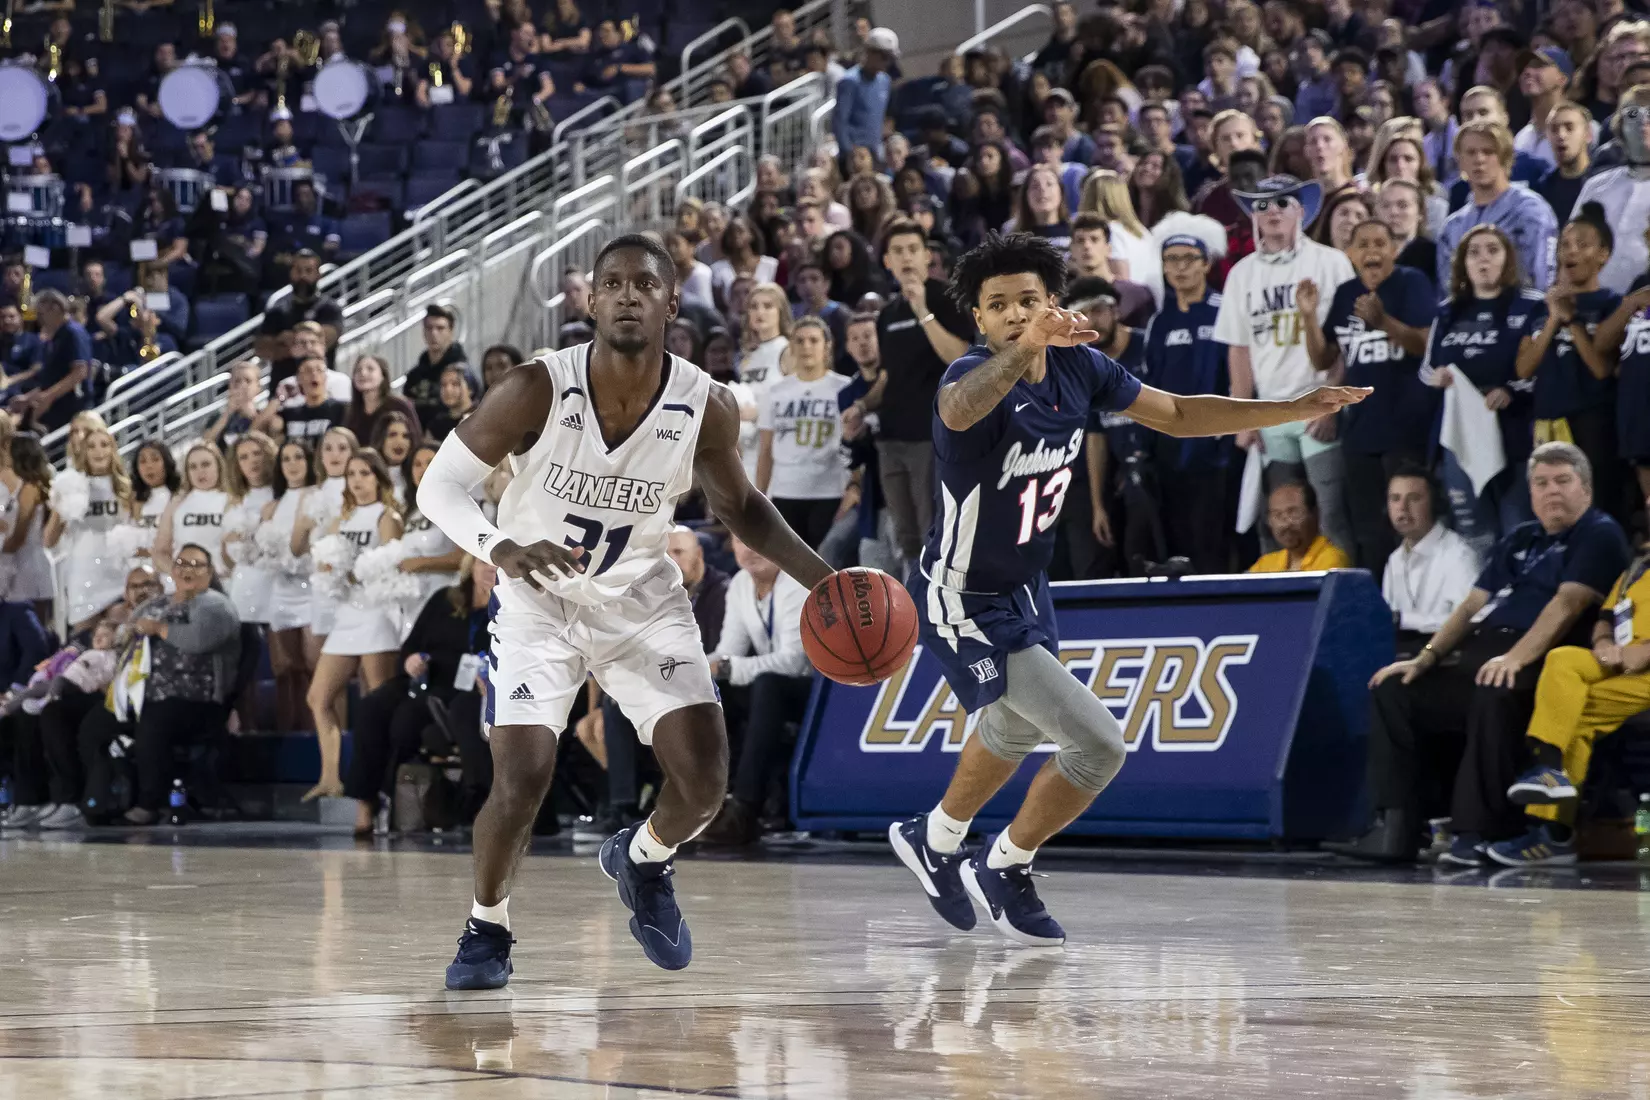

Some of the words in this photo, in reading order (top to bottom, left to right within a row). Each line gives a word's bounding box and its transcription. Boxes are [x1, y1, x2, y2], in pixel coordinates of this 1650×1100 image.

[1247, 283, 1298, 317] LANC
[1441, 330, 1499, 347] CRAZ
[775, 399, 836, 419] LANCE
[560, 418, 584, 432] adidas
[655, 428, 682, 442] WAC
[795, 419, 836, 448] UP
[997, 437, 1066, 490] Jackson
[543, 462, 665, 514] LANCERS
[183, 513, 223, 527] CBU
[1017, 466, 1073, 545] 13
[562, 512, 634, 579] 31
[509, 693, 535, 701] adidas
[859, 634, 1260, 753] LAERS
